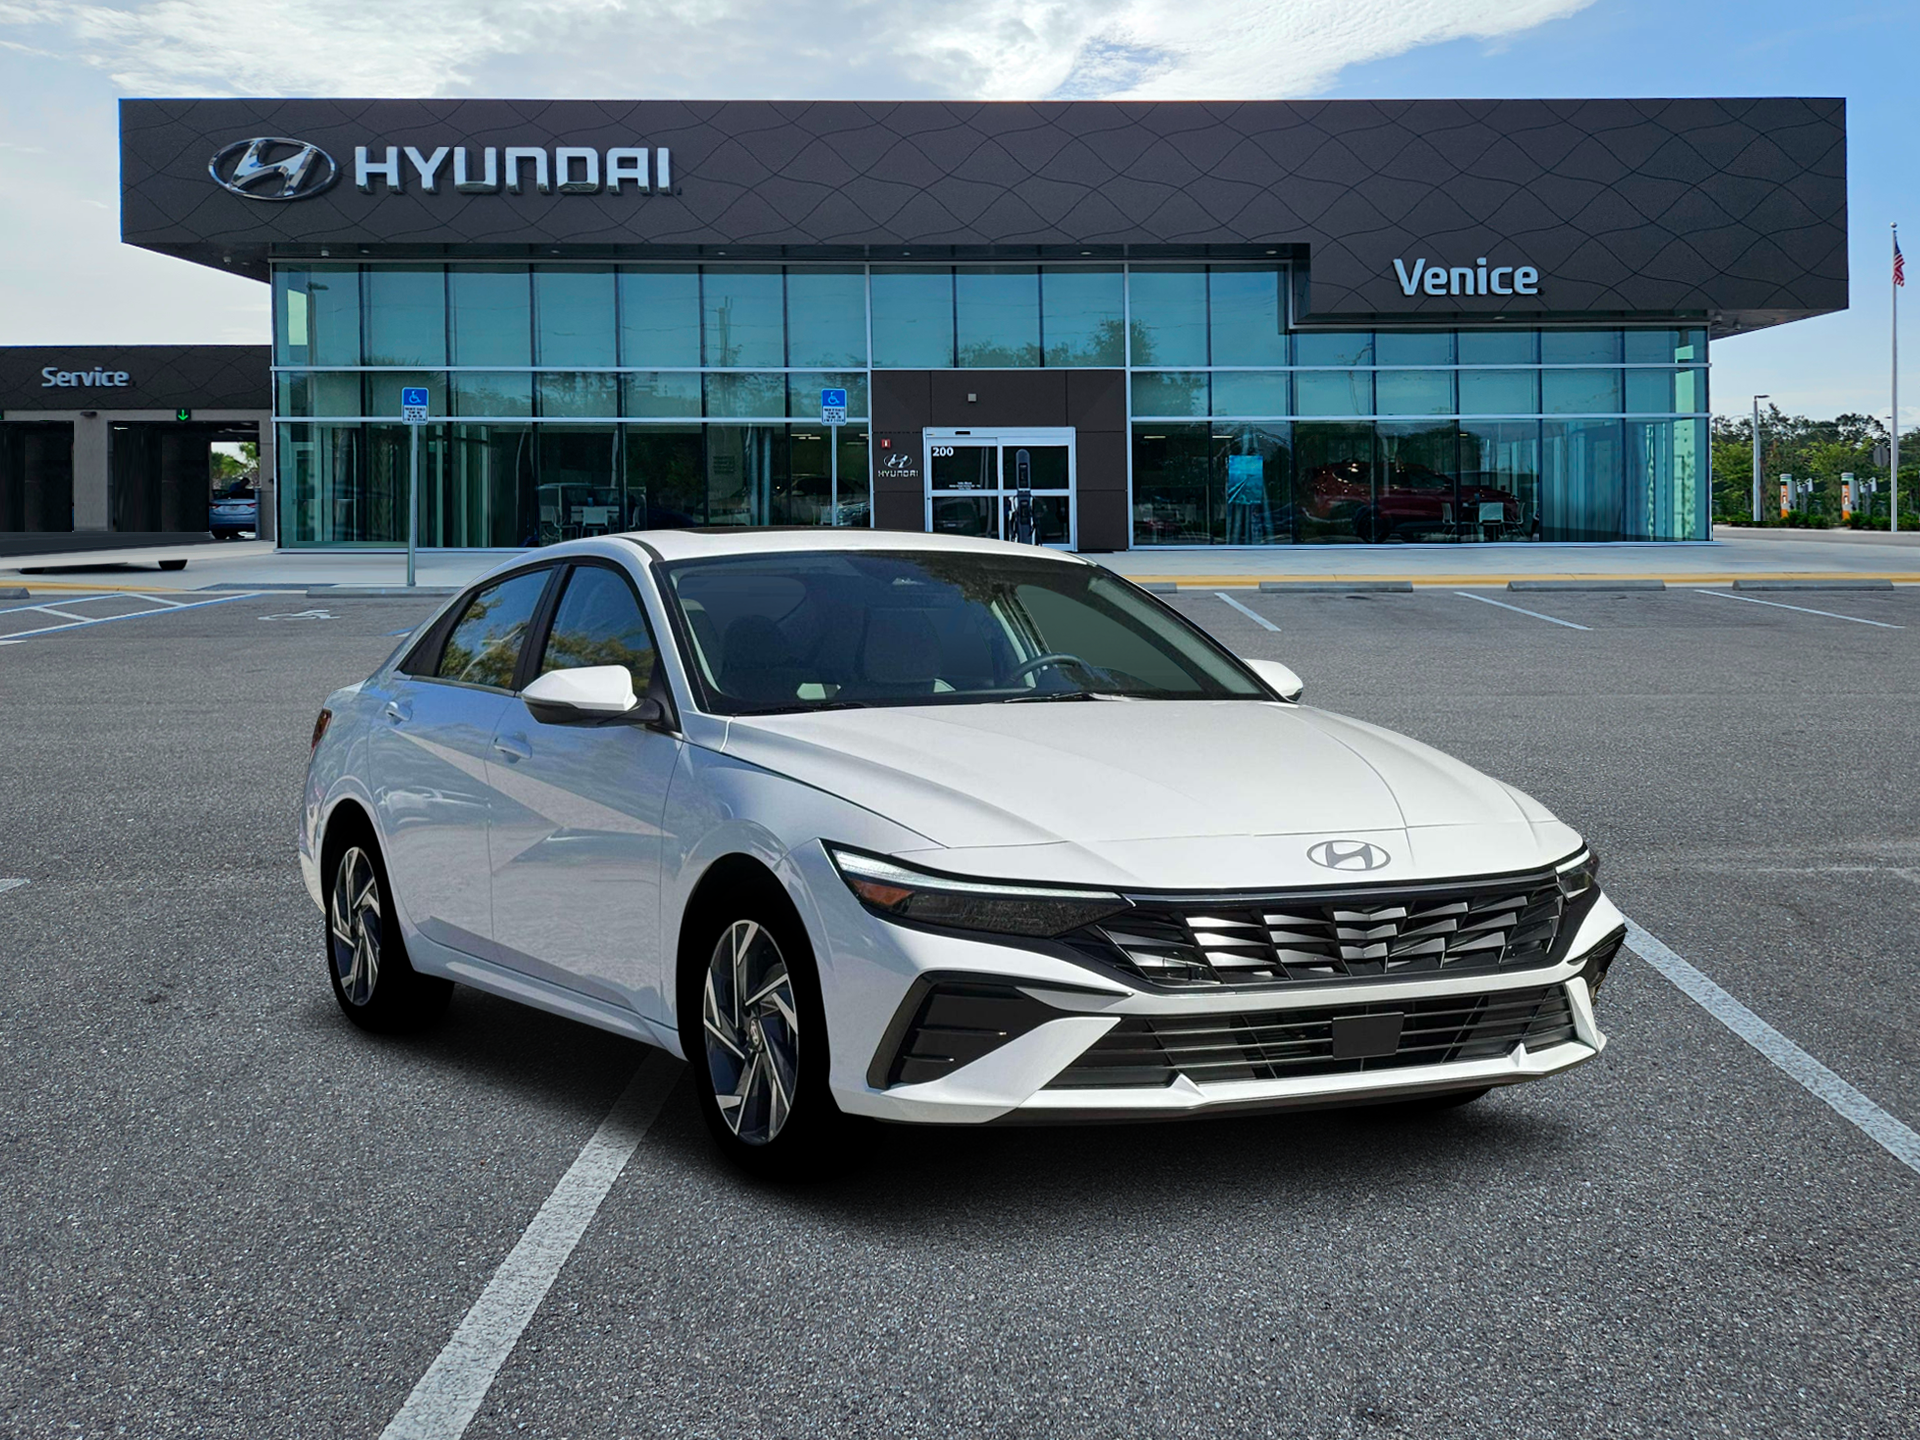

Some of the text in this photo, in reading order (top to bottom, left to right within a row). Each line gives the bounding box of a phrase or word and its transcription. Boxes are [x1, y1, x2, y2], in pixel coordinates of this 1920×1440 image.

[354, 146, 671, 194] HYUNDAI
[1393, 257, 1539, 297] Venice
[41, 366, 130, 387] Service
[932, 446, 954, 457] 200
[877, 470, 919, 478] HYUNDAI
